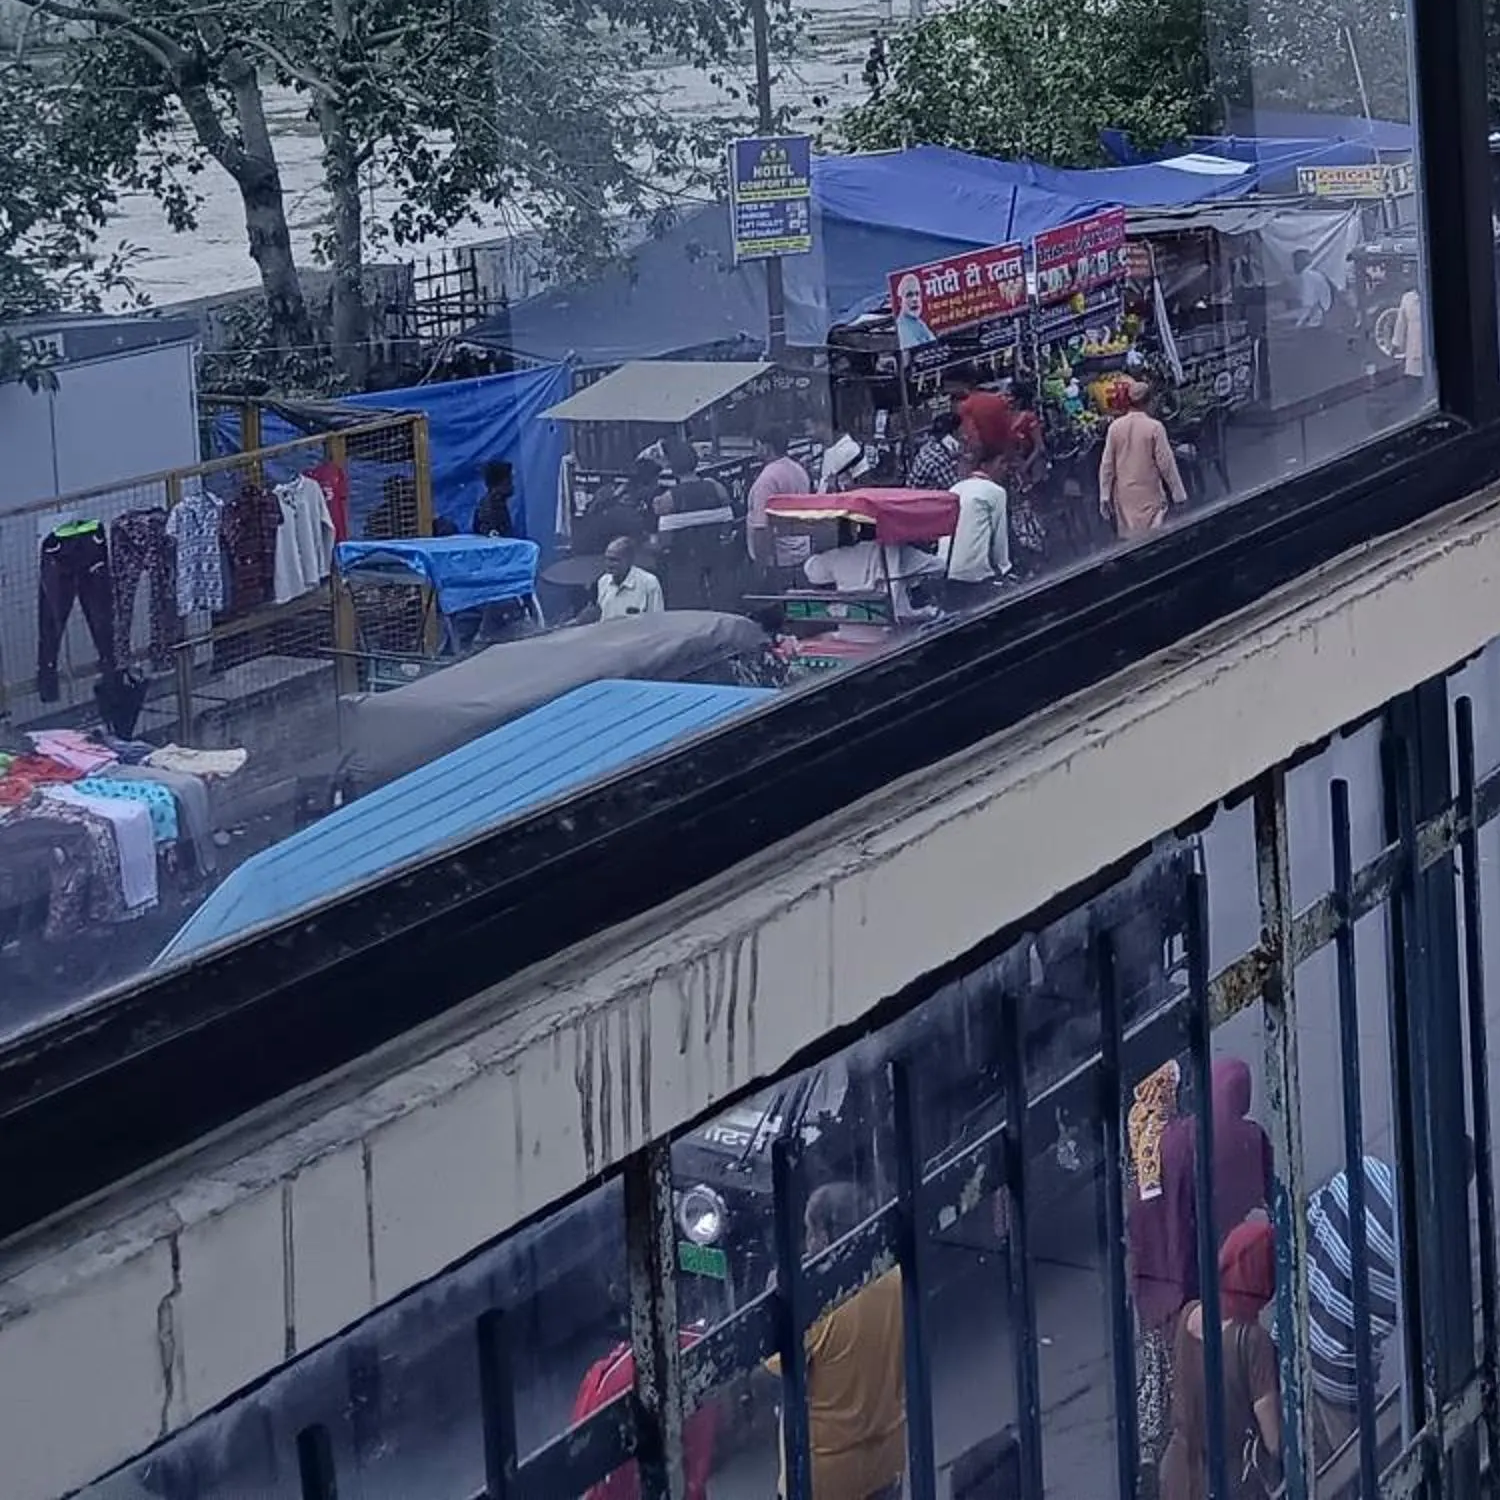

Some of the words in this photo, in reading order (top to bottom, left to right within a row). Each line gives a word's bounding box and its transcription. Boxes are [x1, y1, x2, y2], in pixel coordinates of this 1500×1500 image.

[753, 164, 795, 179] HOTEL
[923, 267, 961, 297] मोदी
[964, 262, 981, 288] टी
